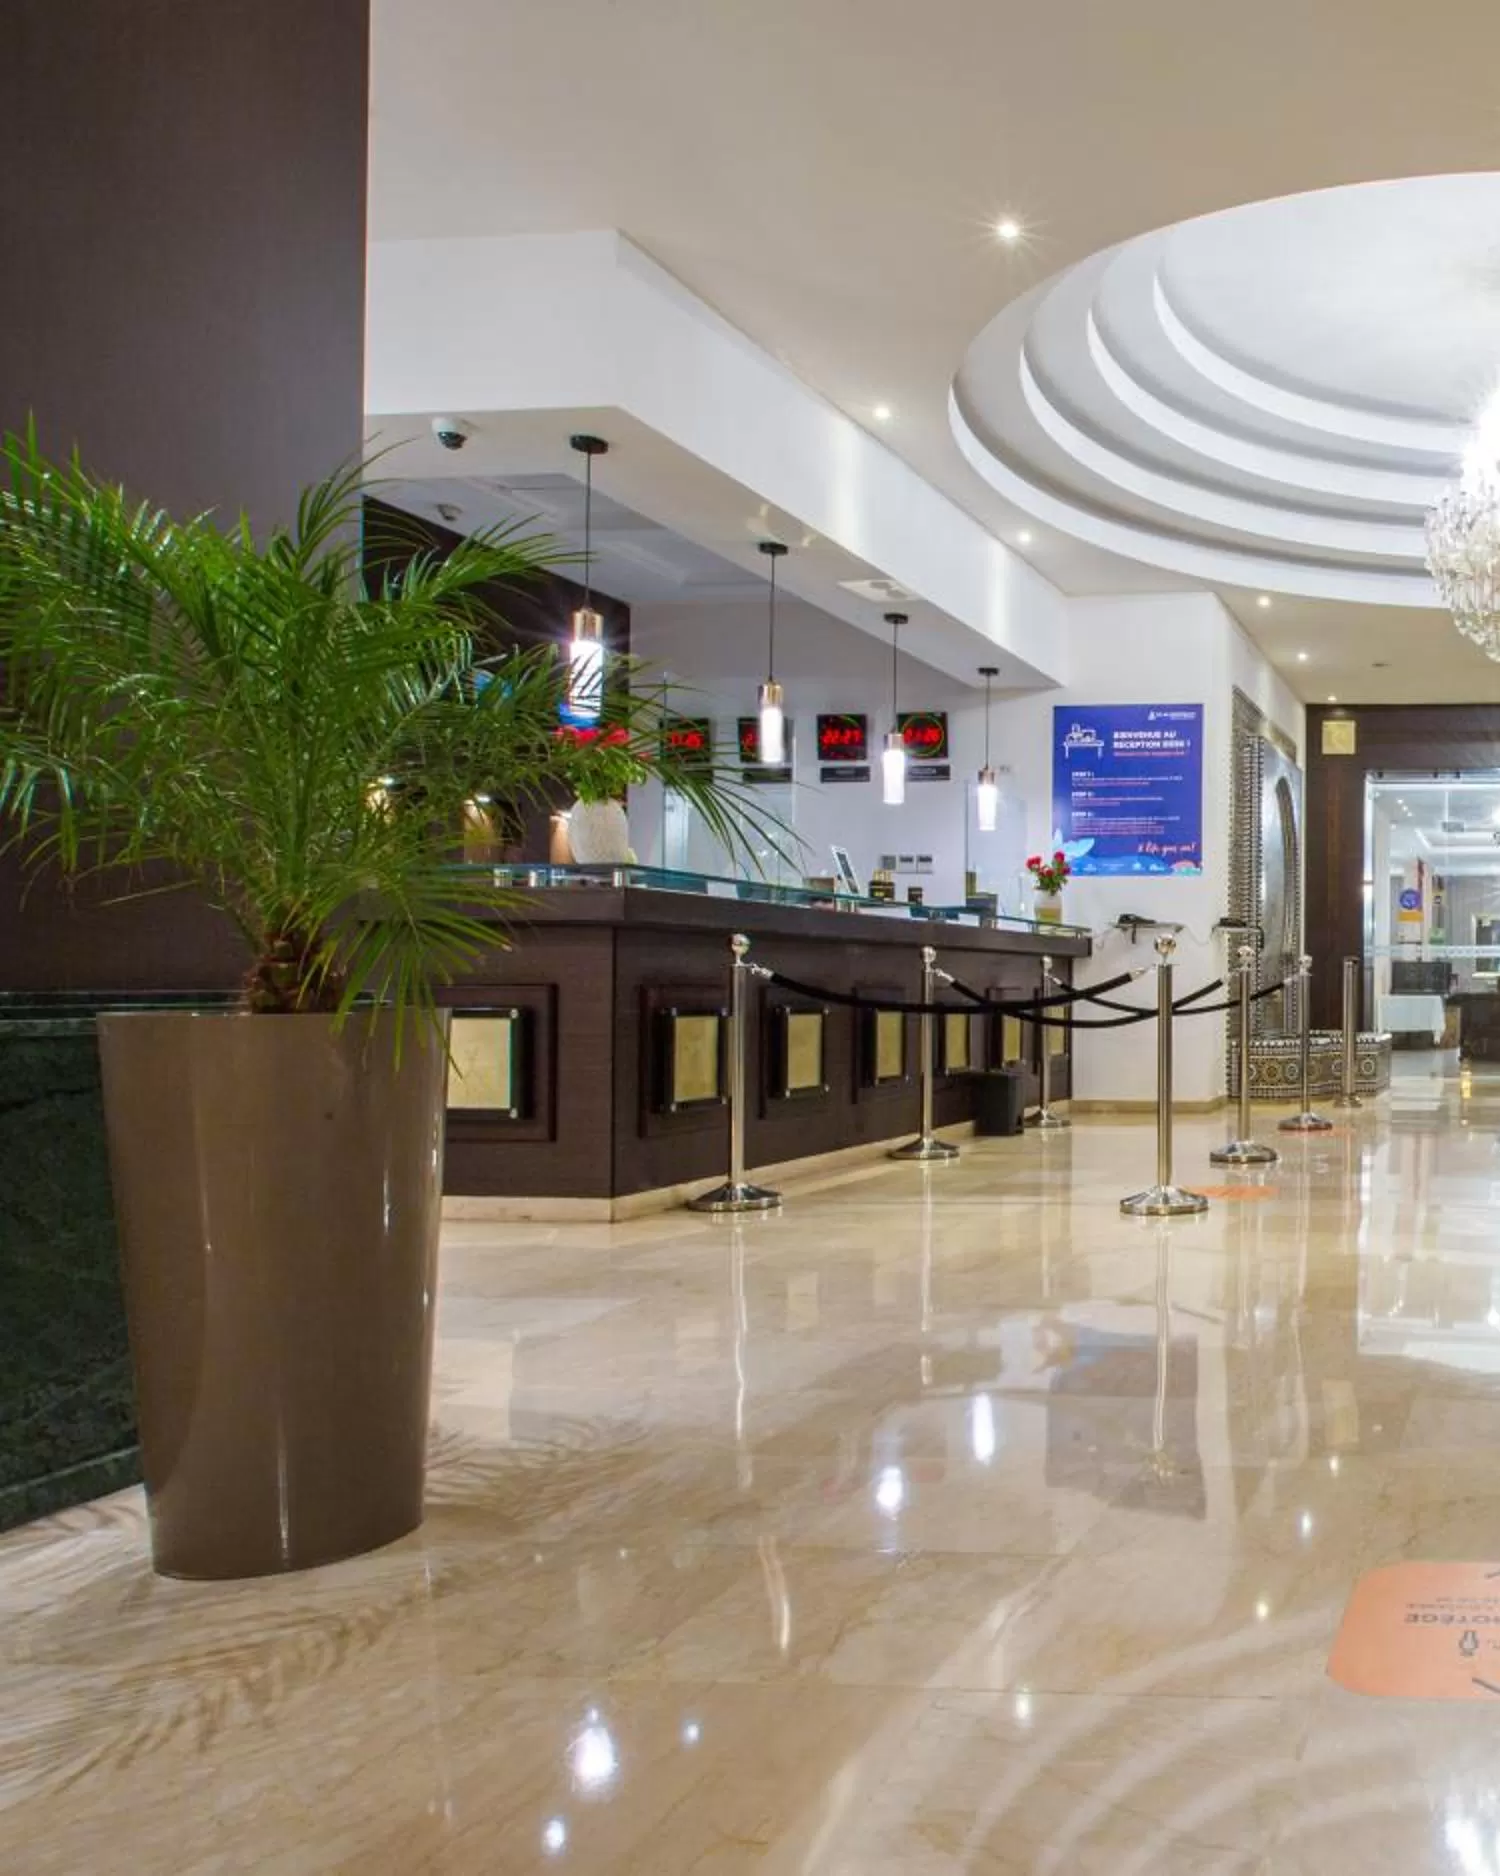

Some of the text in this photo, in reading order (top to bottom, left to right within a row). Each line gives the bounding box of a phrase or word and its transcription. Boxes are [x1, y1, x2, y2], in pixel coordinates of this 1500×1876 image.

[1113, 730, 1177, 738] BIENVENUE AU
[1113, 740, 1161, 748] RECEPTION
